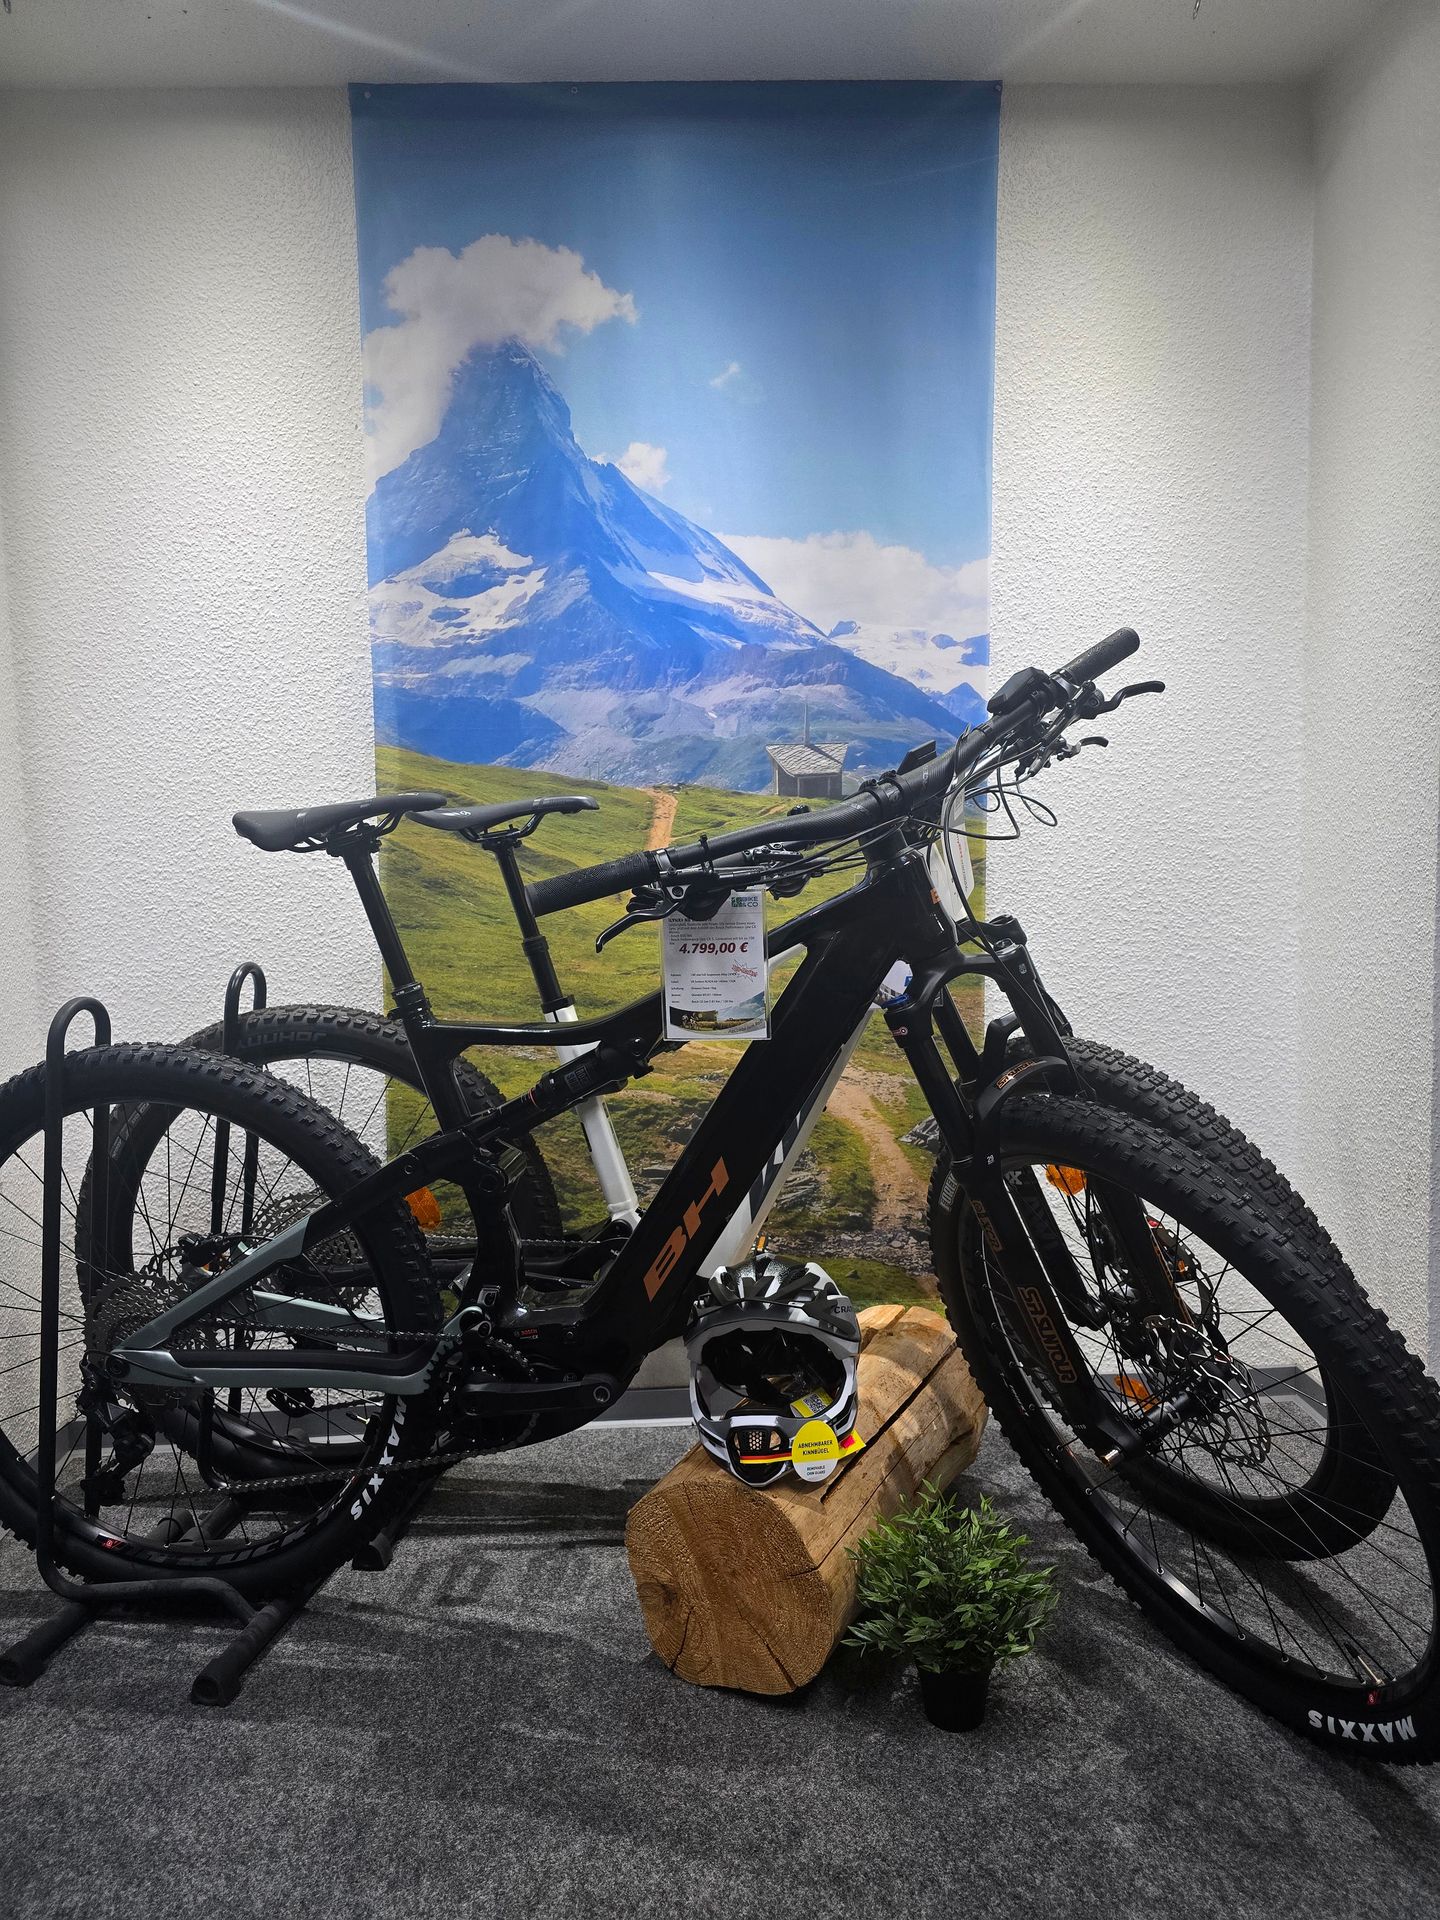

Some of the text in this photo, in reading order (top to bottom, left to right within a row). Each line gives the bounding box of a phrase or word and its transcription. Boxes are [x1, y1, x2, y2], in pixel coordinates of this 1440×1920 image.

[679, 941, 749, 956] 4.799,00 €
[643, 1156, 730, 1303] BH
[798, 1440, 833, 1449] ABNEHMBARER
[1307, 1709, 1417, 1743] MAXXIS
